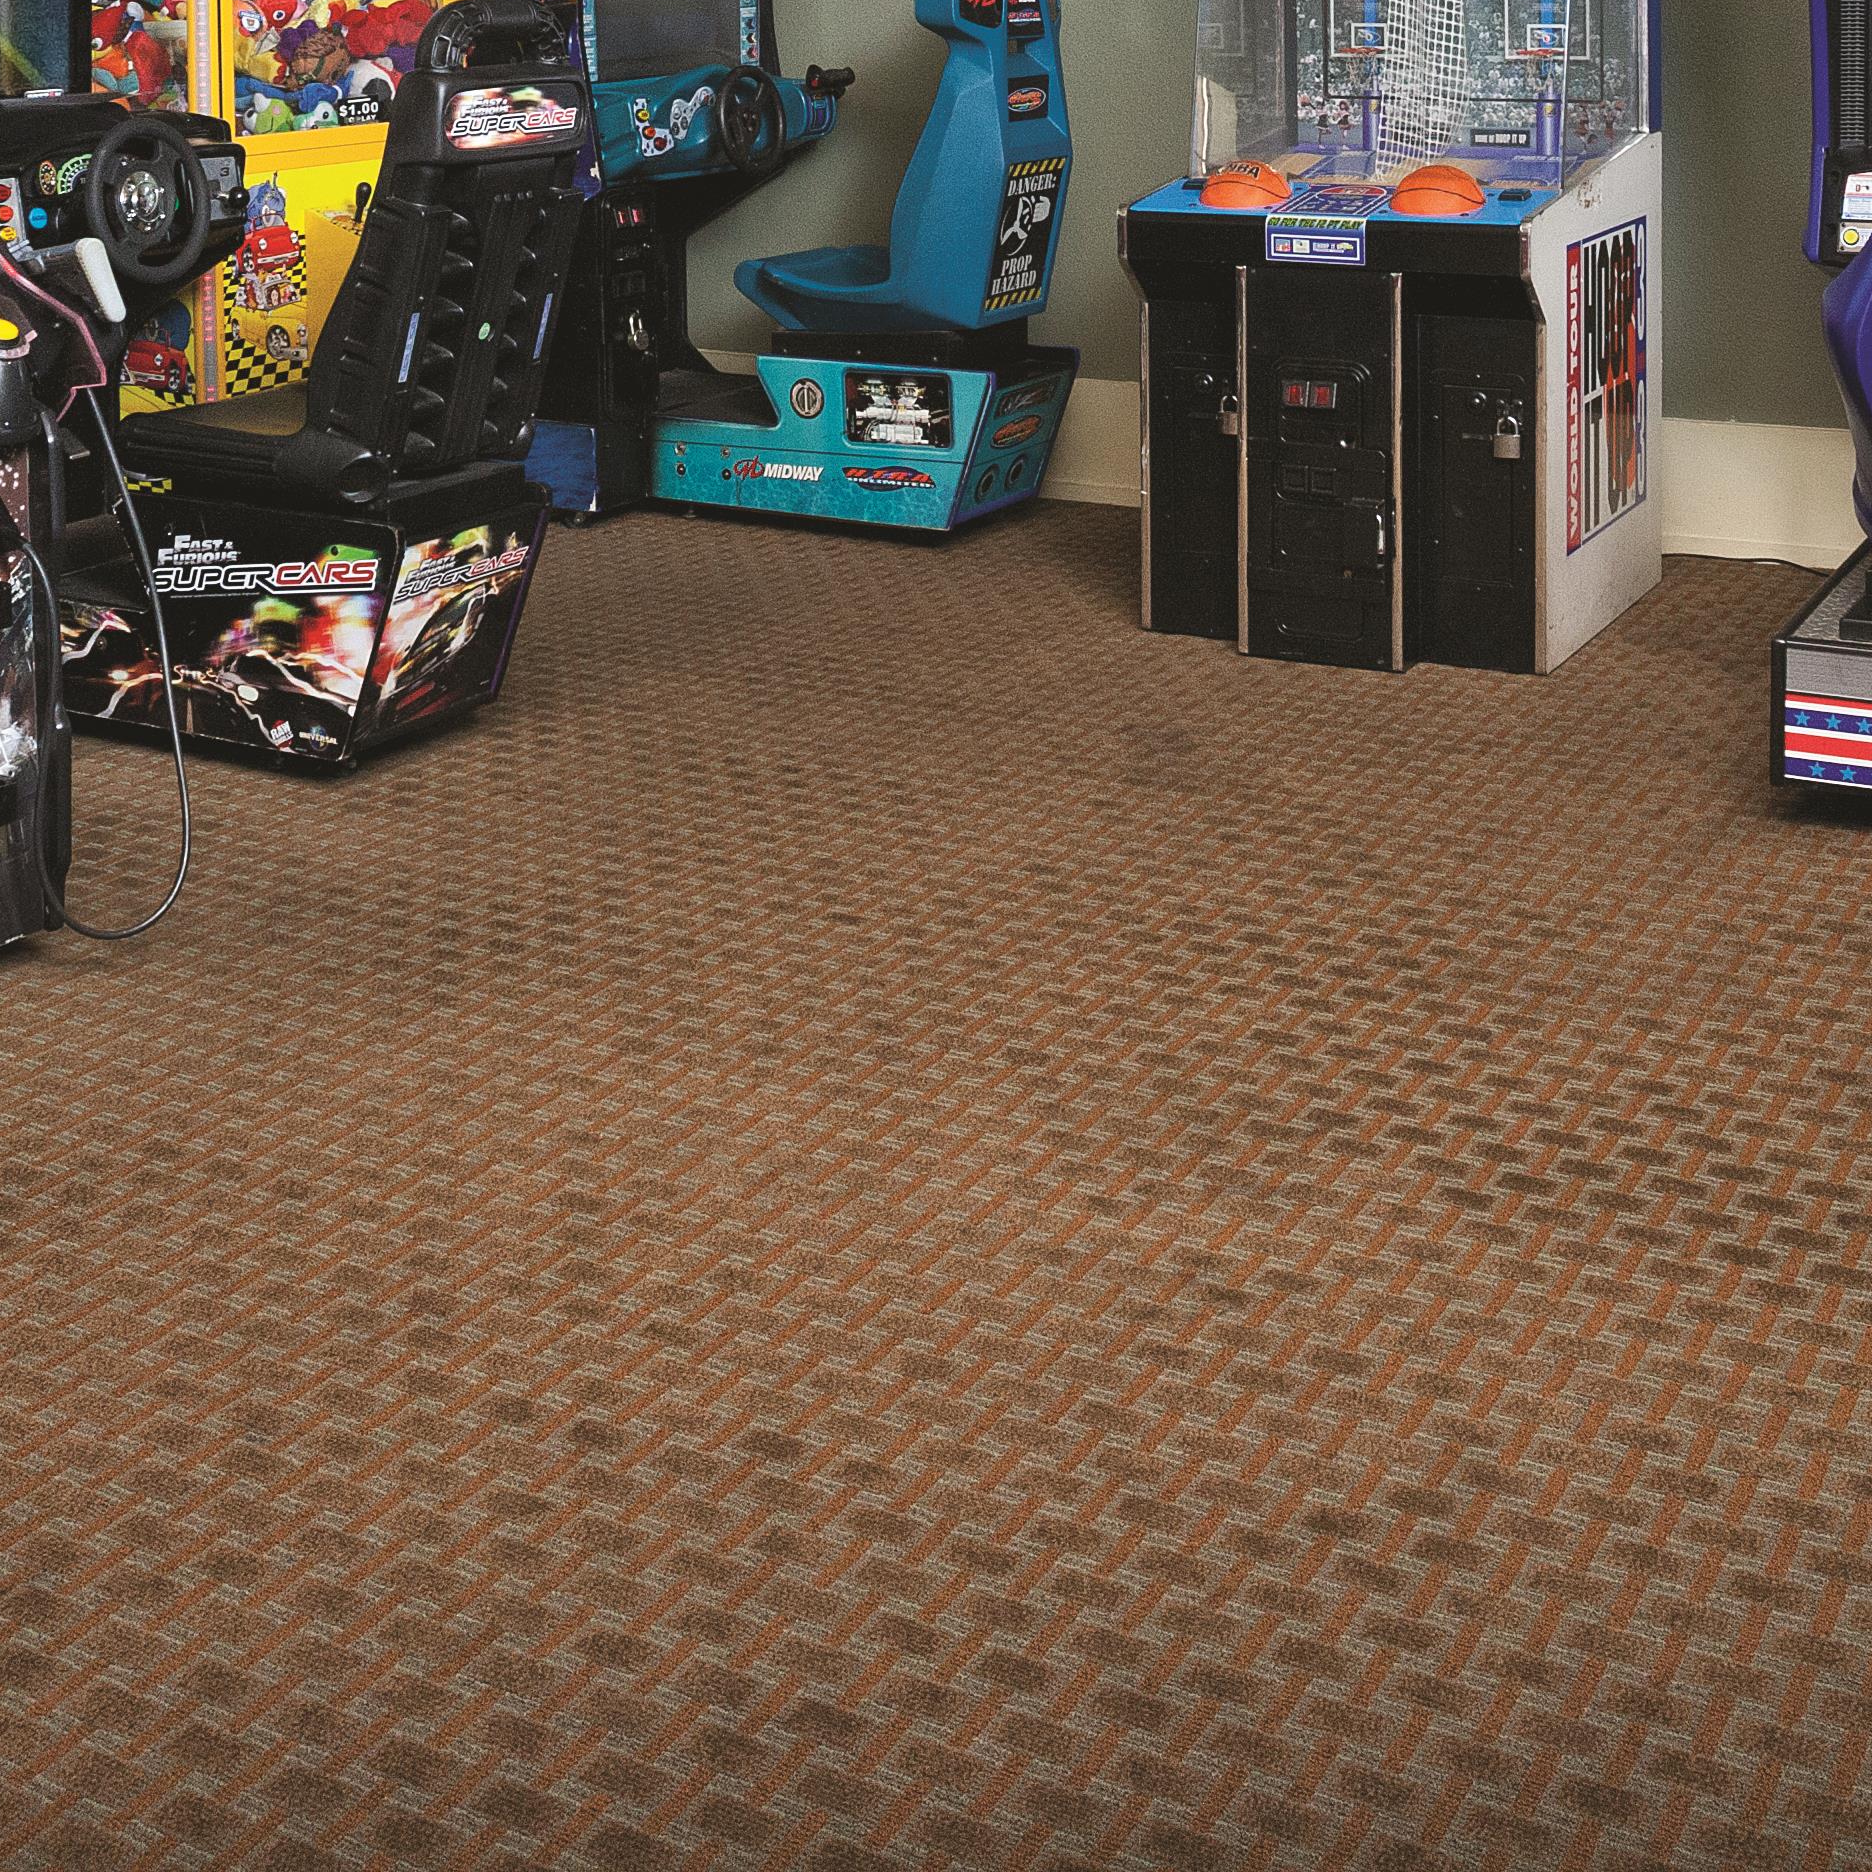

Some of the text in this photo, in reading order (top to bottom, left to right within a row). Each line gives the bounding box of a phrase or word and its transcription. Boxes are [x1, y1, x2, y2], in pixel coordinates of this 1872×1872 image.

[339, 102, 379, 118] $1.00
[1007, 173, 1056, 197] DANGER:
[1001, 254, 1032, 277] PROP
[991, 276, 1037, 296] HAZARD
[763, 463, 824, 481] MIDWAY
[174, 534, 223, 552] FAST
[157, 548, 238, 567] FURIOUS
